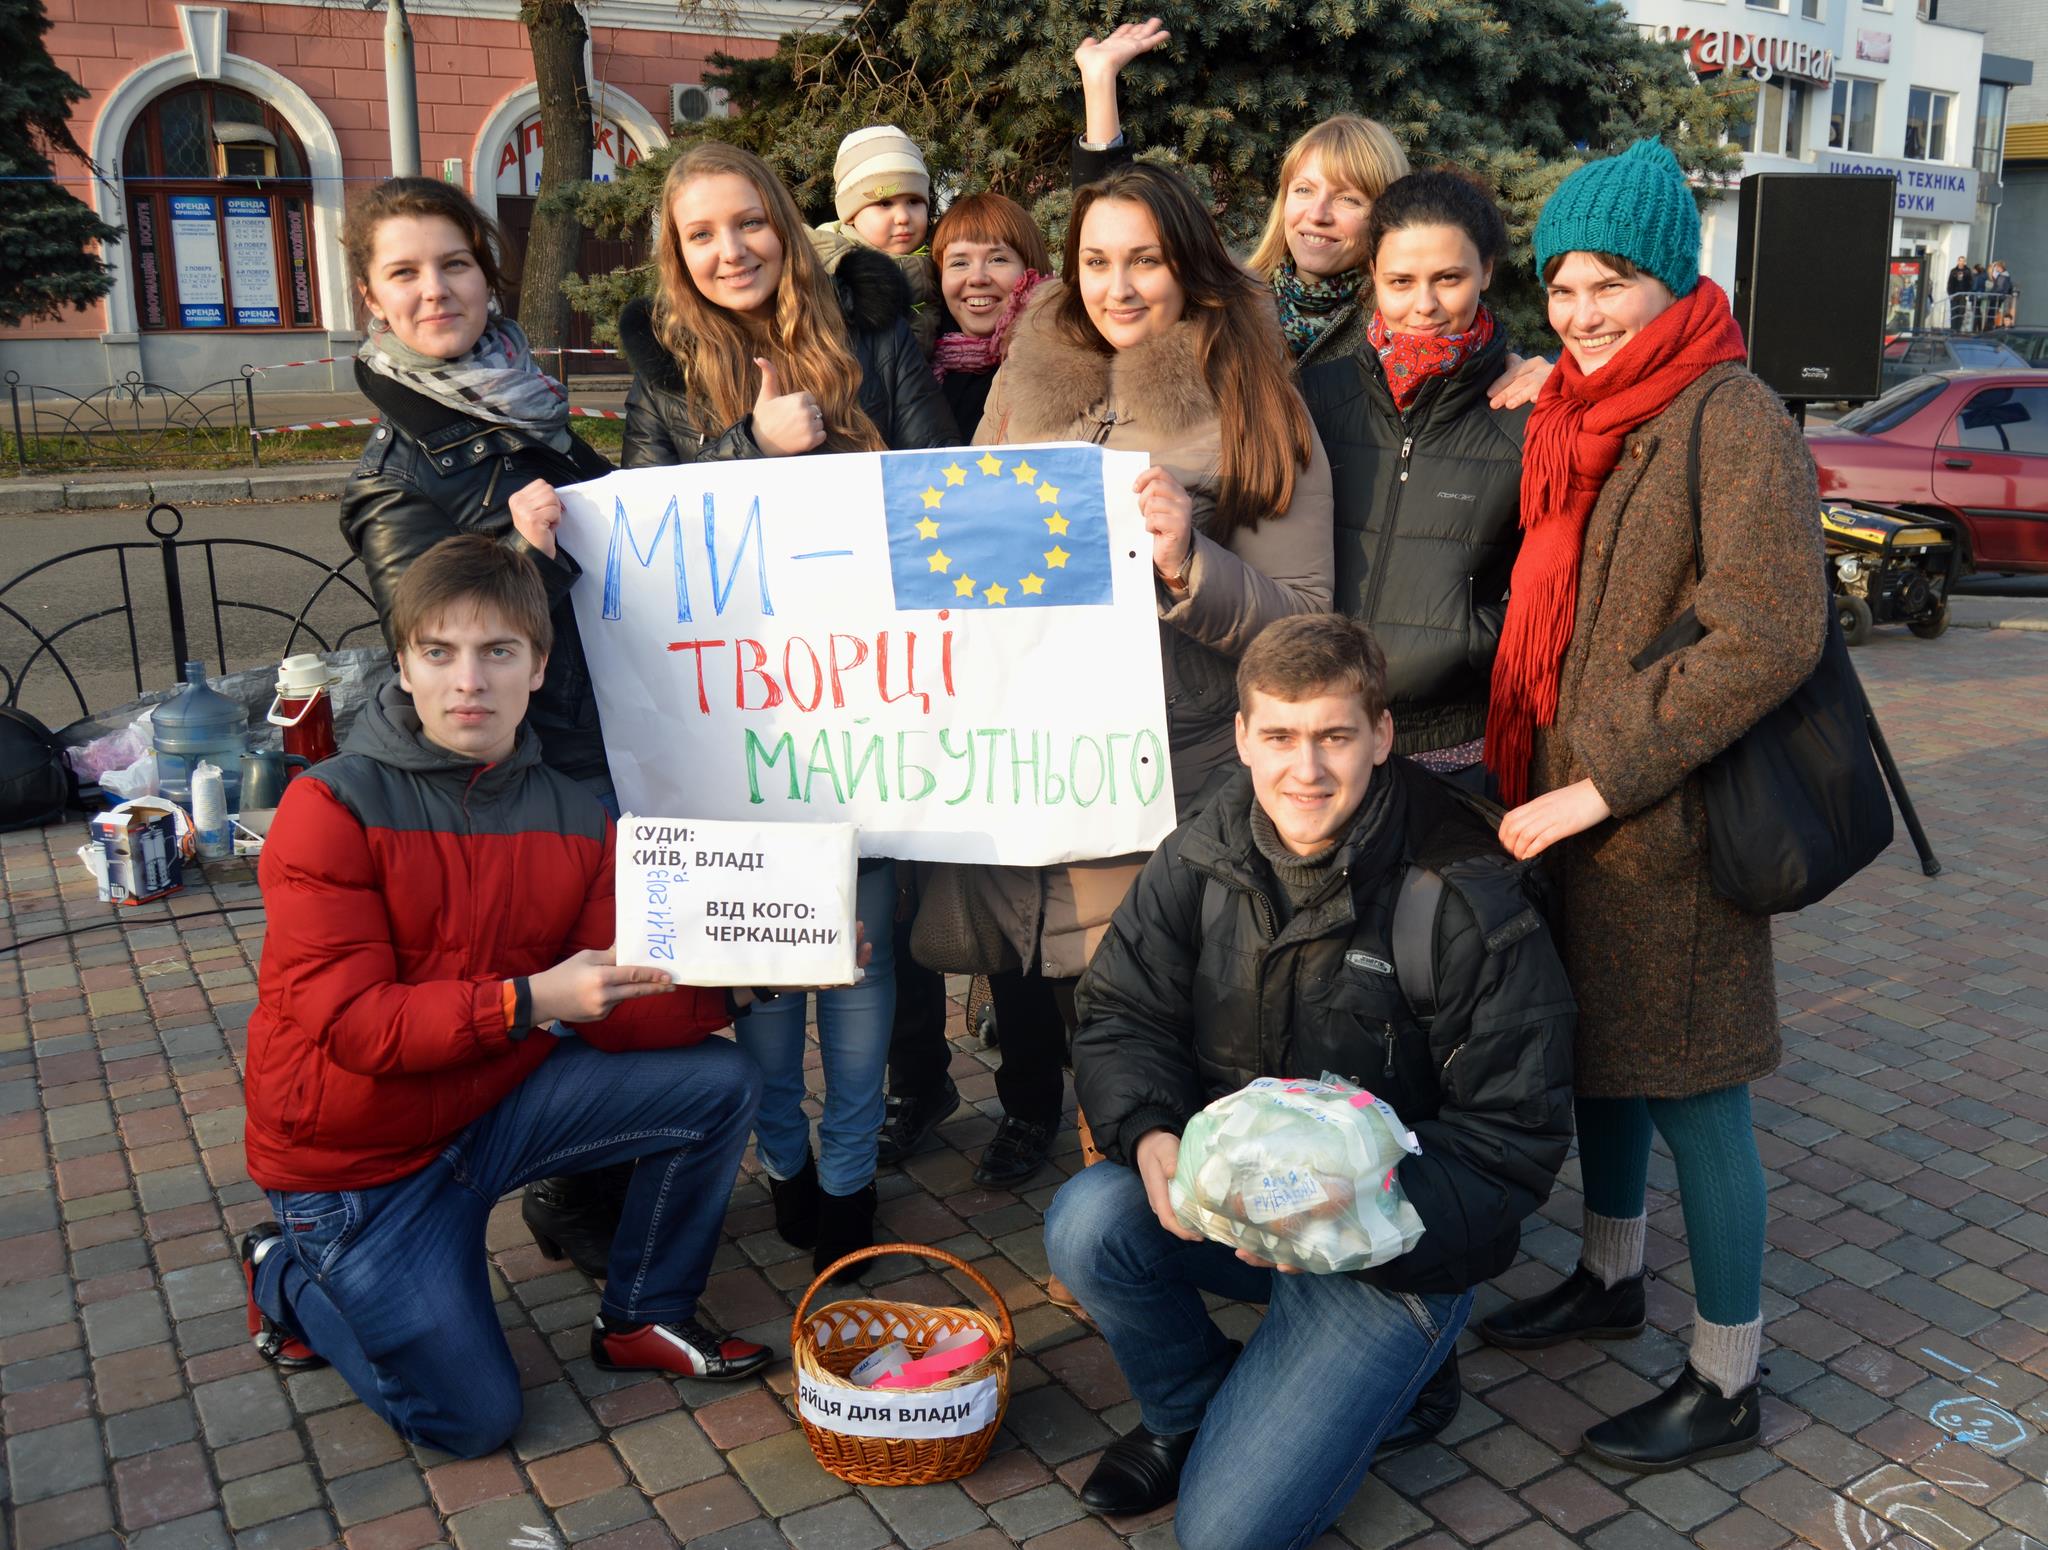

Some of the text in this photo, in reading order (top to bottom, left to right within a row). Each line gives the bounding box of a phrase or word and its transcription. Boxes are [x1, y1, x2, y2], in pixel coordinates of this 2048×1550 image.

[497, 120, 639, 179] АПКА
[1908, 171, 1966, 192] ТЕХНІКА
[174, 202, 210, 210] ОРЕНДА
[228, 200, 265, 208] ОРЕНДА
[1896, 194, 1935, 212] БУКИ
[185, 308, 220, 316] ОРЕНДА
[238, 310, 276, 318] ОРЕНДА
[602, 493, 775, 624] МИ
[667, 609, 956, 715] ТВОРЦІ
[745, 717, 1165, 807] МАЙБУТНЬОГО
[695, 851, 764, 871] ВЛАДІ
[647, 869, 677, 960] 24.11.2013
[706, 901, 815, 920] ВІД КОГО:
[801, 1385, 971, 1424] ЯЙЦЯ ДЛЯ ВЛАДИ
